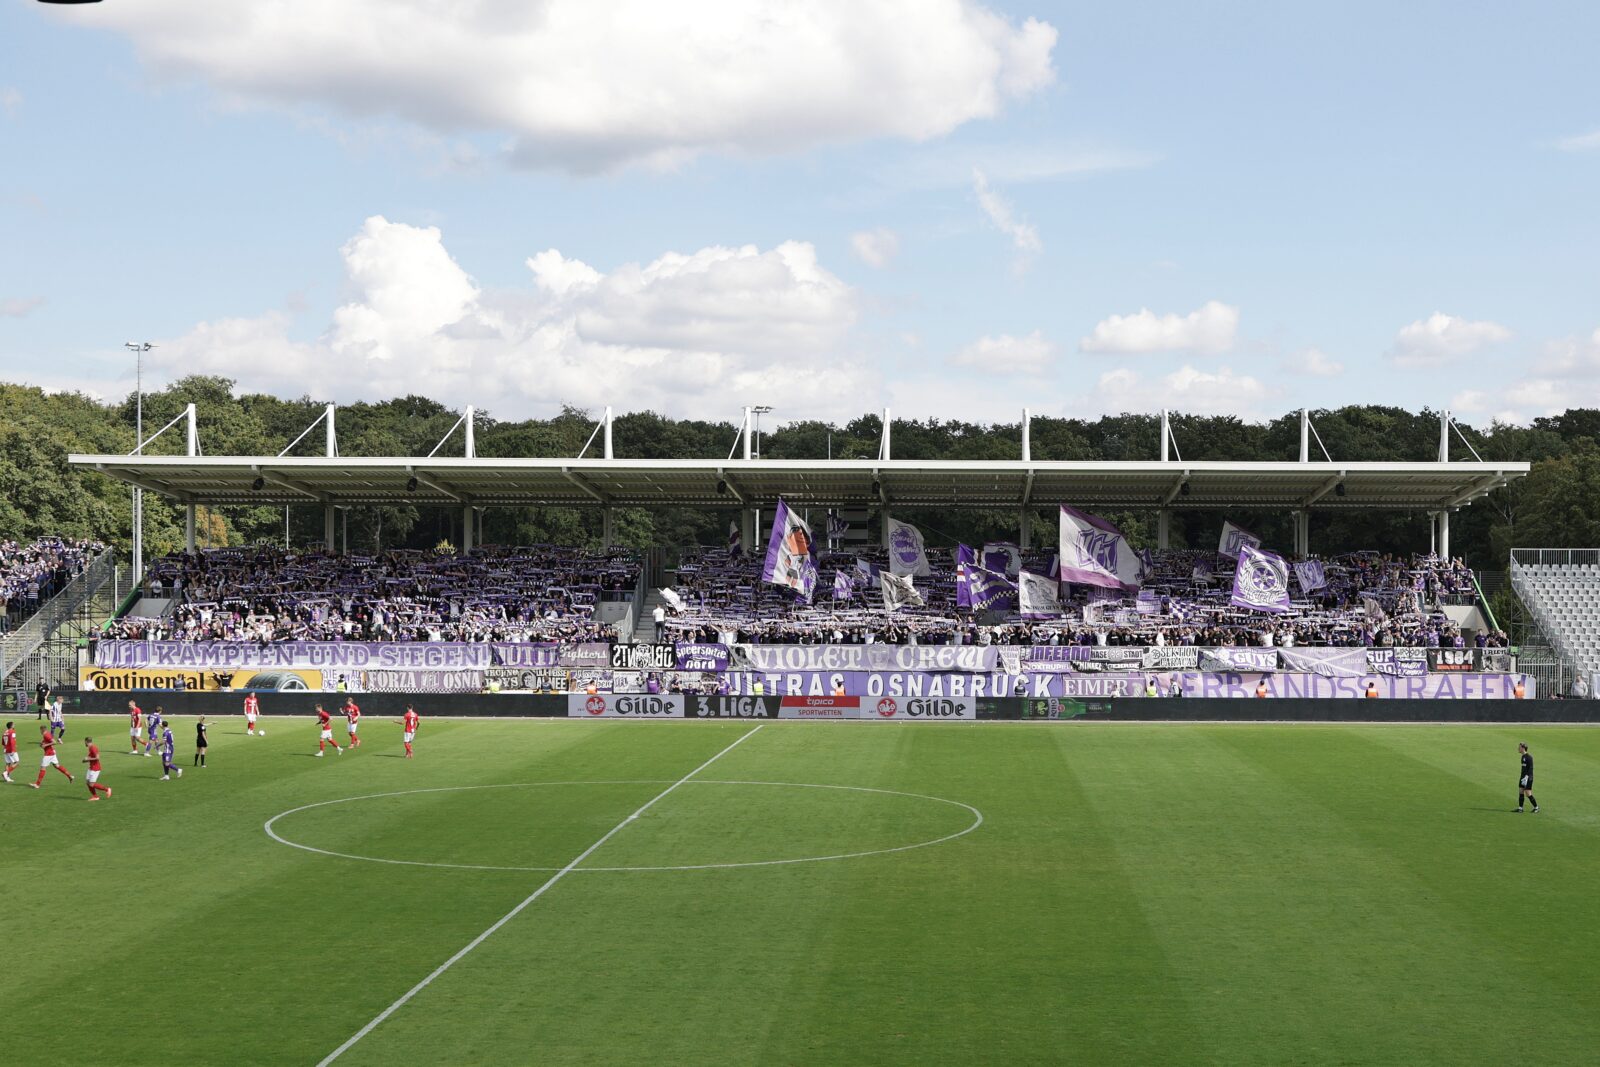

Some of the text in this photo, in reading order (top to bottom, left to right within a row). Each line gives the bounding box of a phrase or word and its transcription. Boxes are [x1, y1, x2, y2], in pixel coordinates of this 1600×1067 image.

[305, 643, 372, 667] UND
[752, 646, 861, 669] VIOLET
[1233, 652, 1277, 668] GUYS
[1436, 650, 1474, 665] 1984
[685, 659, 716, 670] nord
[368, 672, 416, 688] FORZA
[443, 672, 481, 688] OSNA
[615, 696, 675, 717] Gilde
[696, 696, 716, 717] 3.
[806, 697, 834, 706] tipico
[906, 698, 966, 717] Gilde
